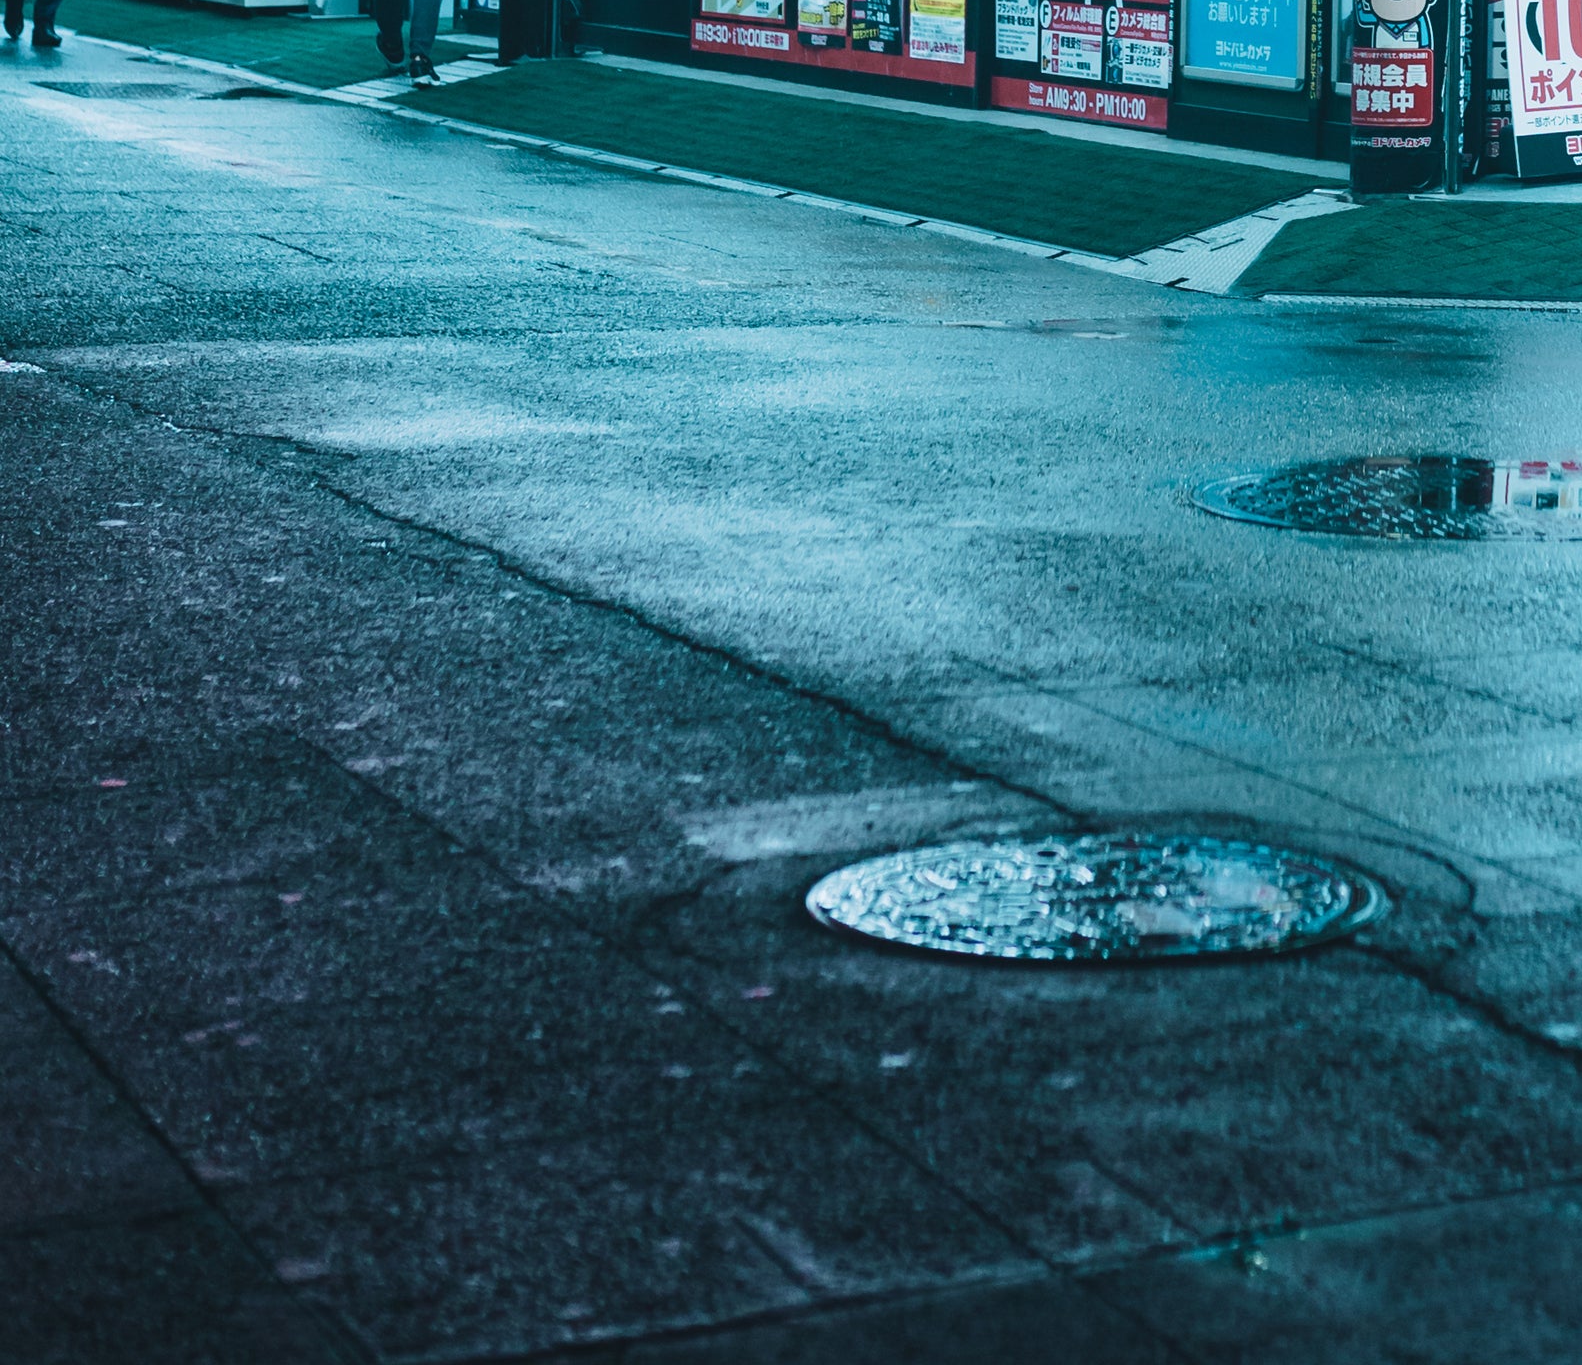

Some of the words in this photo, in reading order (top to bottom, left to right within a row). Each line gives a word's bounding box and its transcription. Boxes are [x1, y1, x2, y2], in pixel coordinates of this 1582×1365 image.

[1120, 10, 1167, 32] カメラ総合館
[1207, 2, 1278, 28] お願いします!
[704, 23, 731, 44] 9:30
[1215, 40, 1272, 62] ヨドバシカメラ
[1352, 63, 1428, 89] 新規会員
[1045, 86, 1088, 113] AM9:30
[1095, 93, 1147, 121] PM10:00
[1355, 89, 1415, 114] 募集中
[1371, 136, 1431, 149] ヨドバシカメラ
